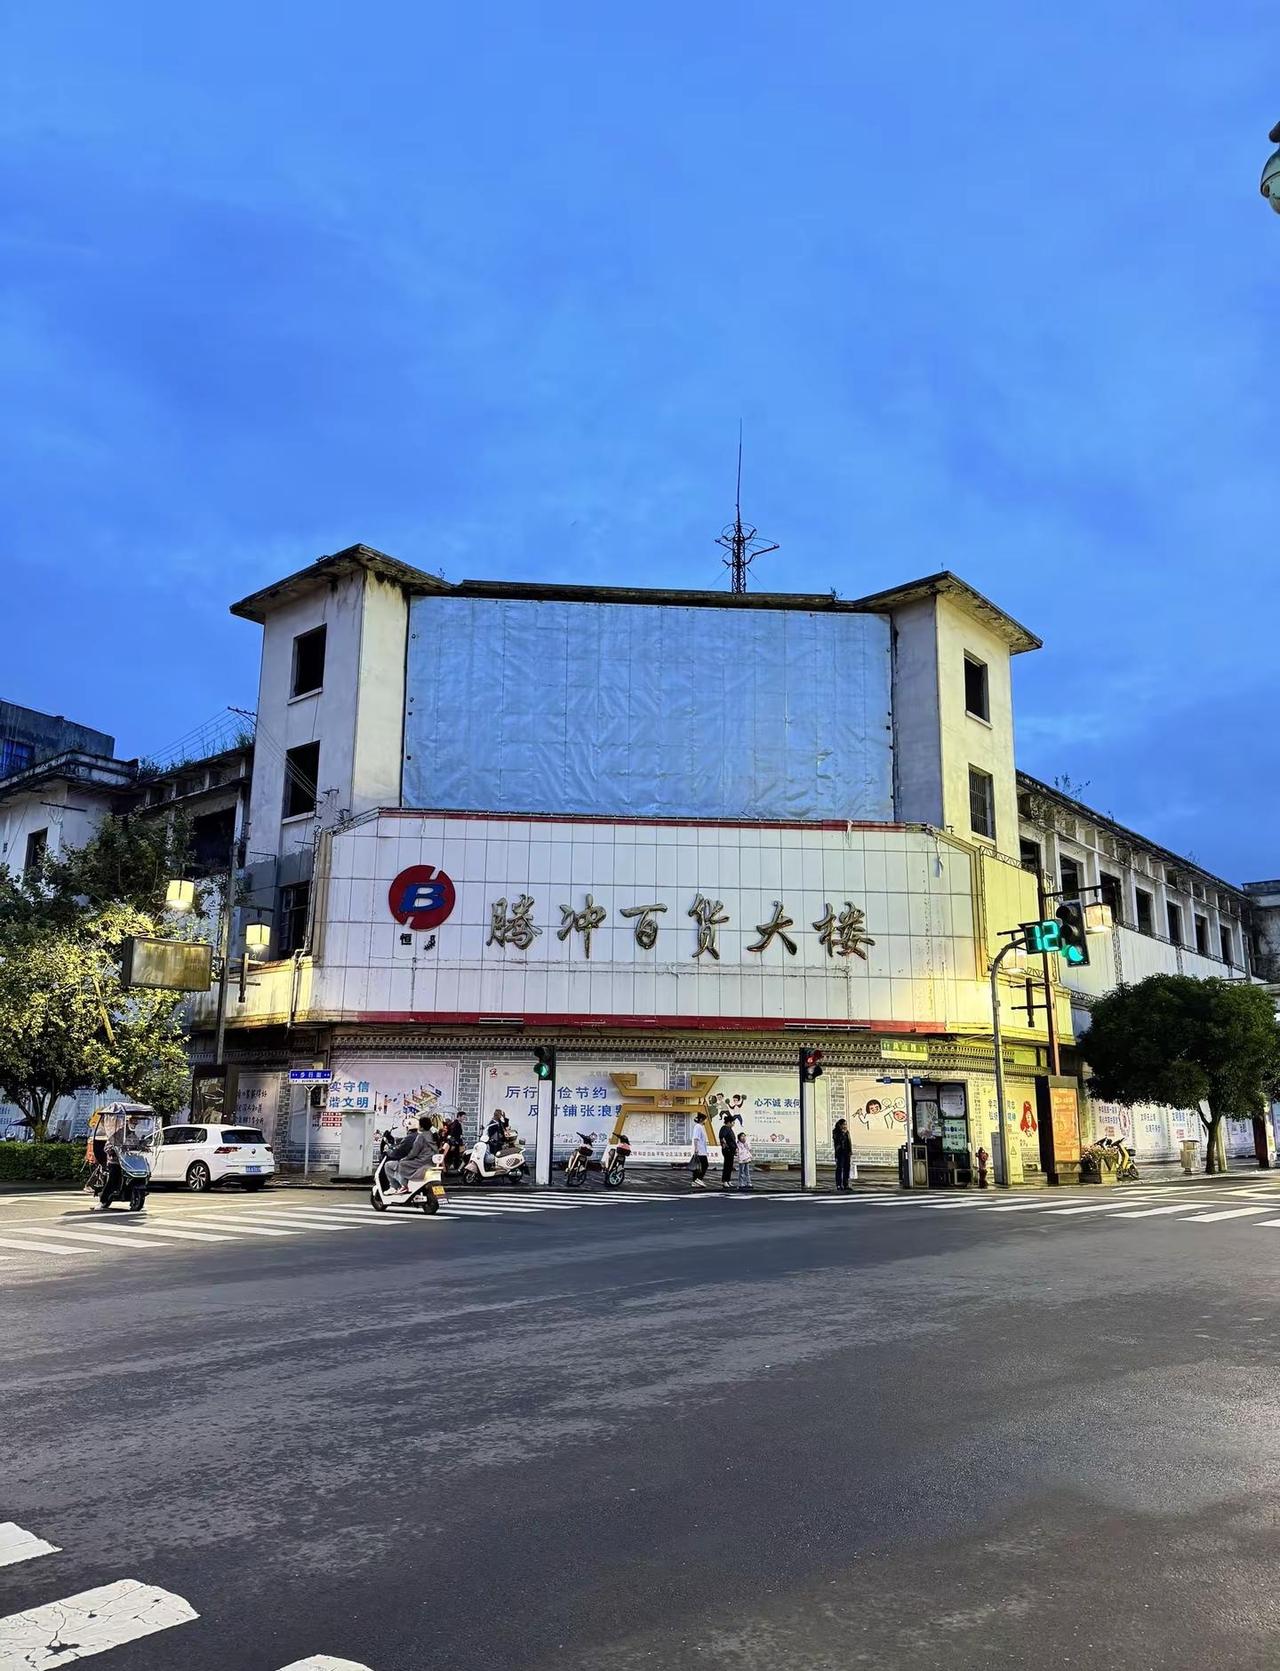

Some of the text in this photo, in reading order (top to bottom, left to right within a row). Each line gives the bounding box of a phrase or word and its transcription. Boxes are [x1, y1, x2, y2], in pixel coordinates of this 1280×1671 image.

[485, 892, 876, 960] 腾冲百货大楼
[1034, 920, 1060, 951] 12
[505, 1085, 607, 1100] 厉行俭节约
